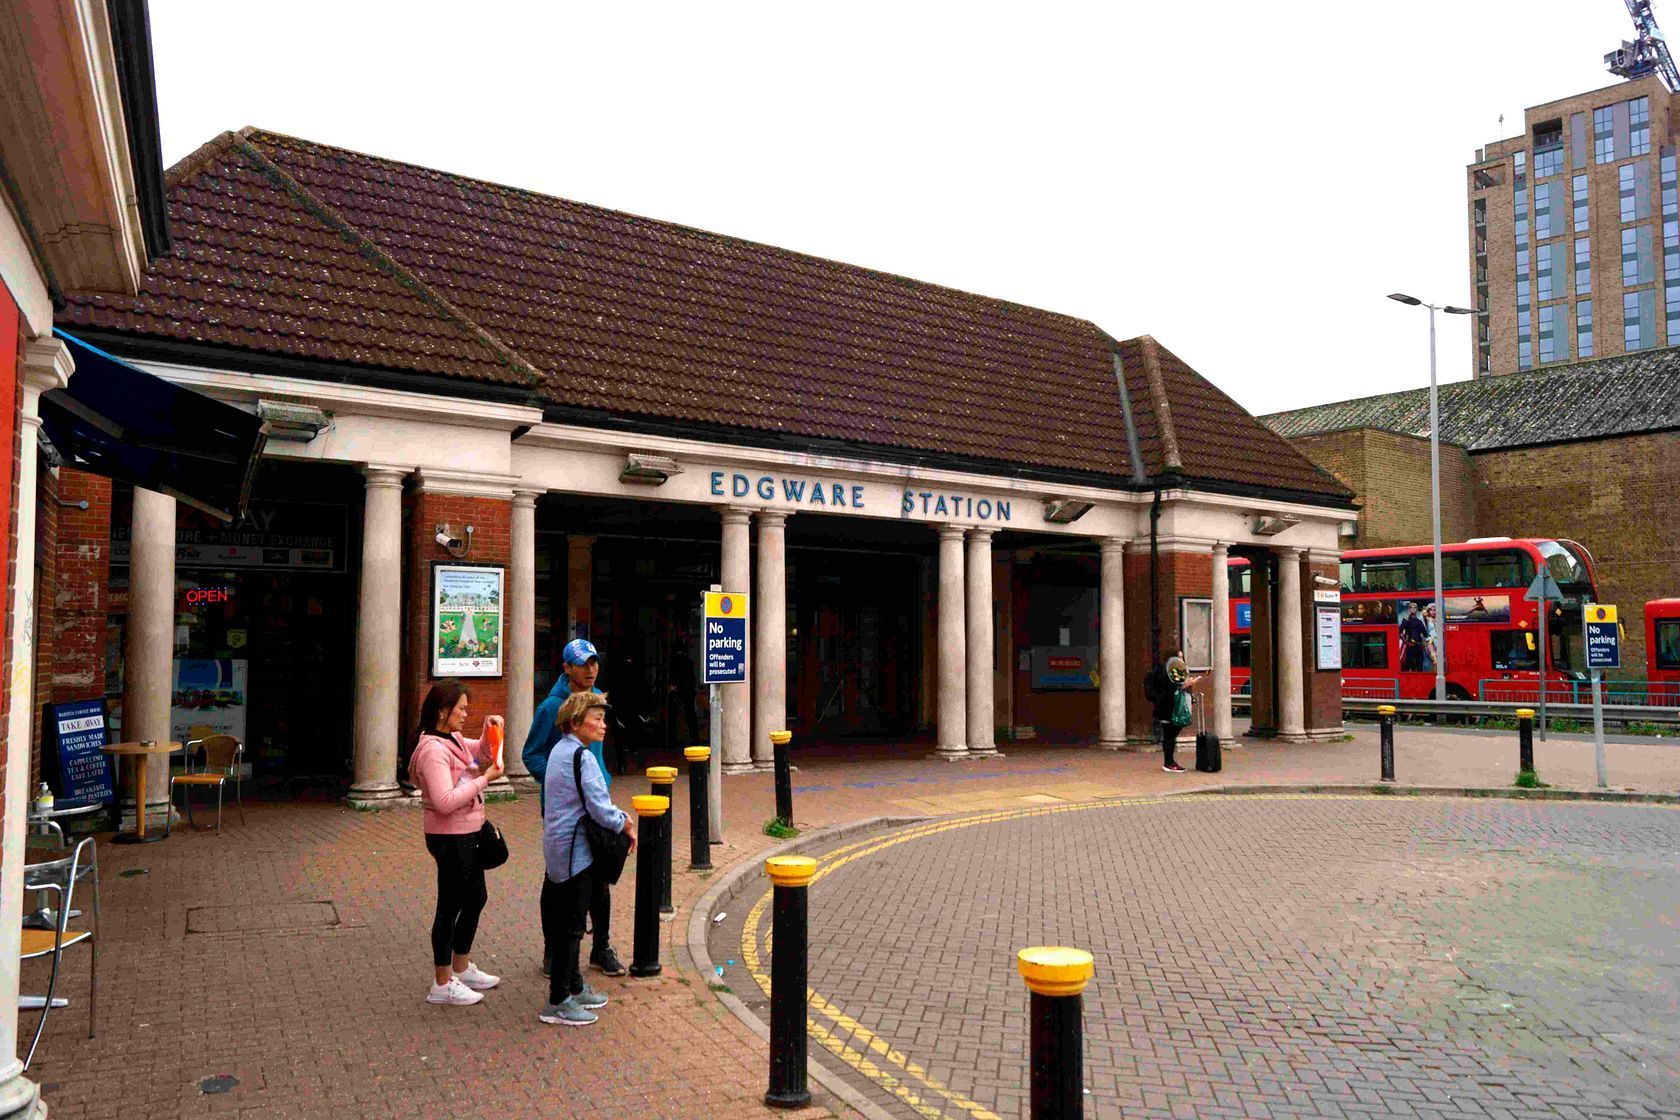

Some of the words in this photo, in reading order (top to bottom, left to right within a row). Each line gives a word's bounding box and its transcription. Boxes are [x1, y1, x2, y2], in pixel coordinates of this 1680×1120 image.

[710, 471, 866, 508] EDGWARE
[902, 490, 1012, 522] STATION
[220, 530, 265, 545] MONEY
[269, 534, 336, 548] EXCHANGE
[186, 589, 228, 602] OPEN
[709, 622, 724, 634] No
[1589, 625, 1601, 634] No
[709, 637, 743, 651] parking
[1589, 635, 1616, 646] parking
[709, 653, 734, 661] Offenders
[709, 668, 737, 676] prosecuted
[61, 720, 82, 731] TAKE
[84, 718, 102, 729] AWAY
[62, 735, 87, 745] FRESHLY
[88, 732, 105, 741] MADE
[66, 740, 102, 752] SANDWICHES
[69, 754, 103, 767] CAPPUCCINO
[67, 767, 79, 775] TEA
[85, 760, 106, 771] COFFEE
[87, 768, 105, 778] LATTE
[74, 784, 105, 796] BREAKFAST
[88, 789, 113, 801] PASTRIES
